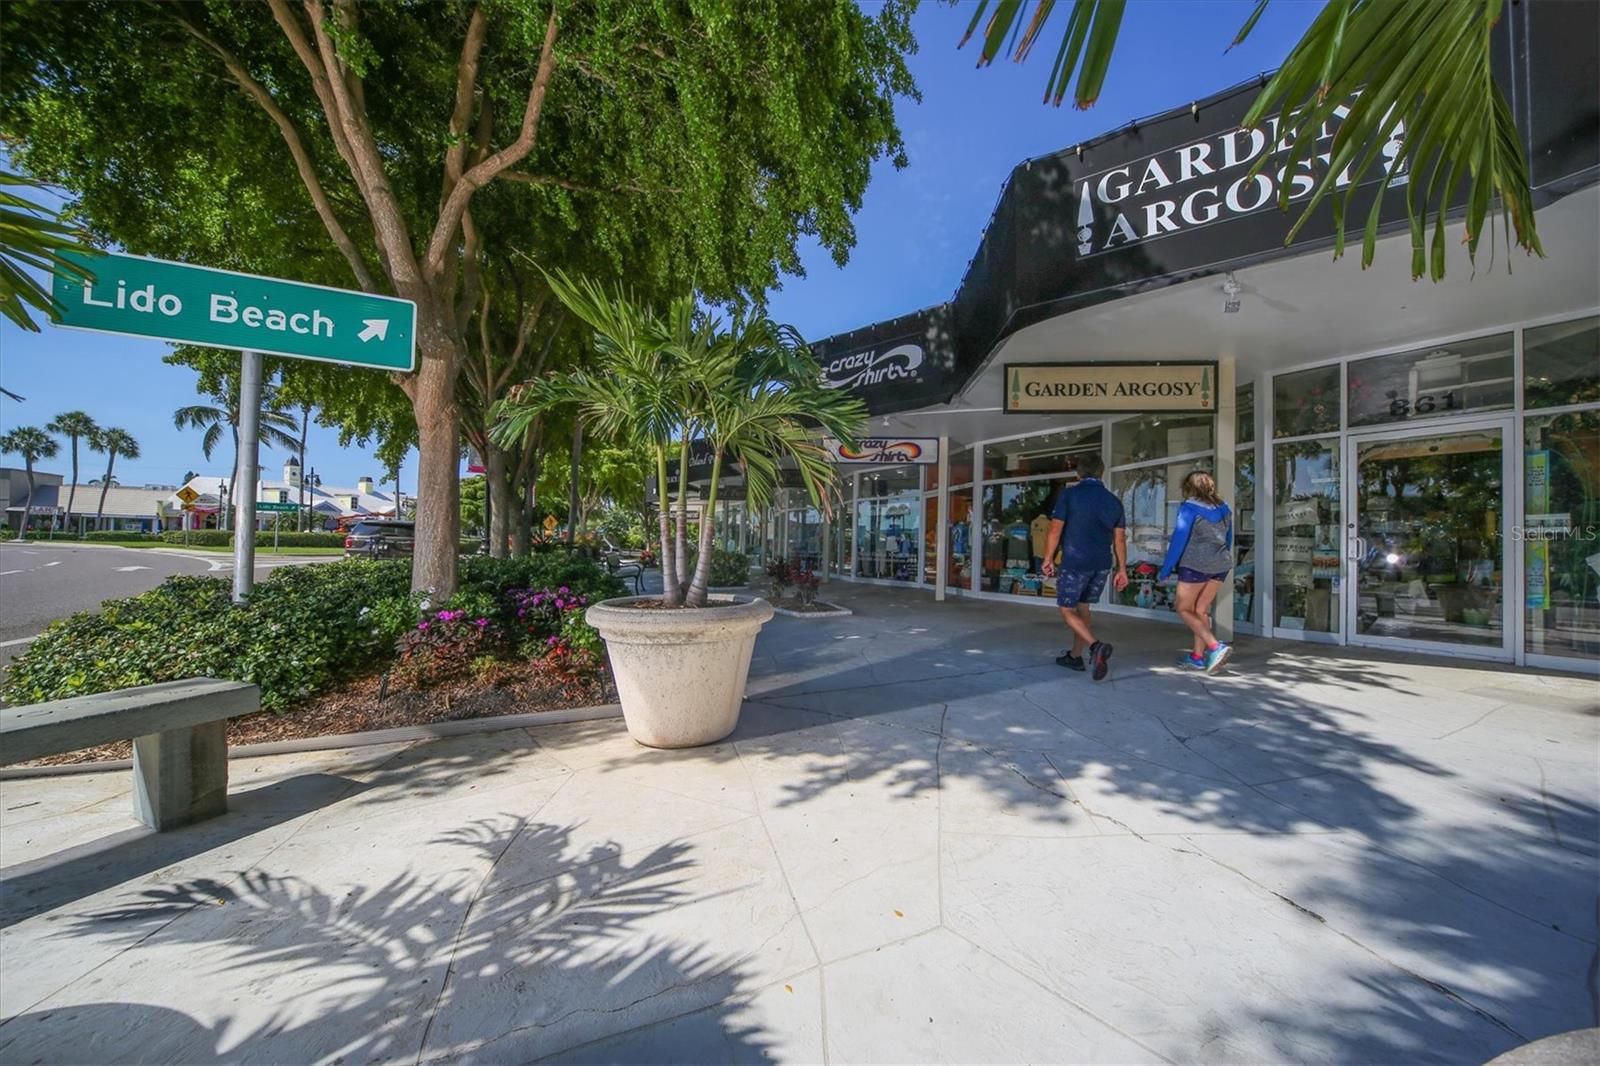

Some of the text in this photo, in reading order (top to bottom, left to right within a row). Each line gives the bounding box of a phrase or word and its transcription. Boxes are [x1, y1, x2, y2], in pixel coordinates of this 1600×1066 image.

[1097, 88, 1363, 204] GARDE
[83, 279, 334, 337] Lido Beach
[830, 350, 875, 372] crazy
[852, 363, 908, 388] shirts
[1025, 381, 1197, 397] GARDEN ARGOSY
[1389, 391, 1455, 416] 861
[870, 451, 912, 462] shirts
